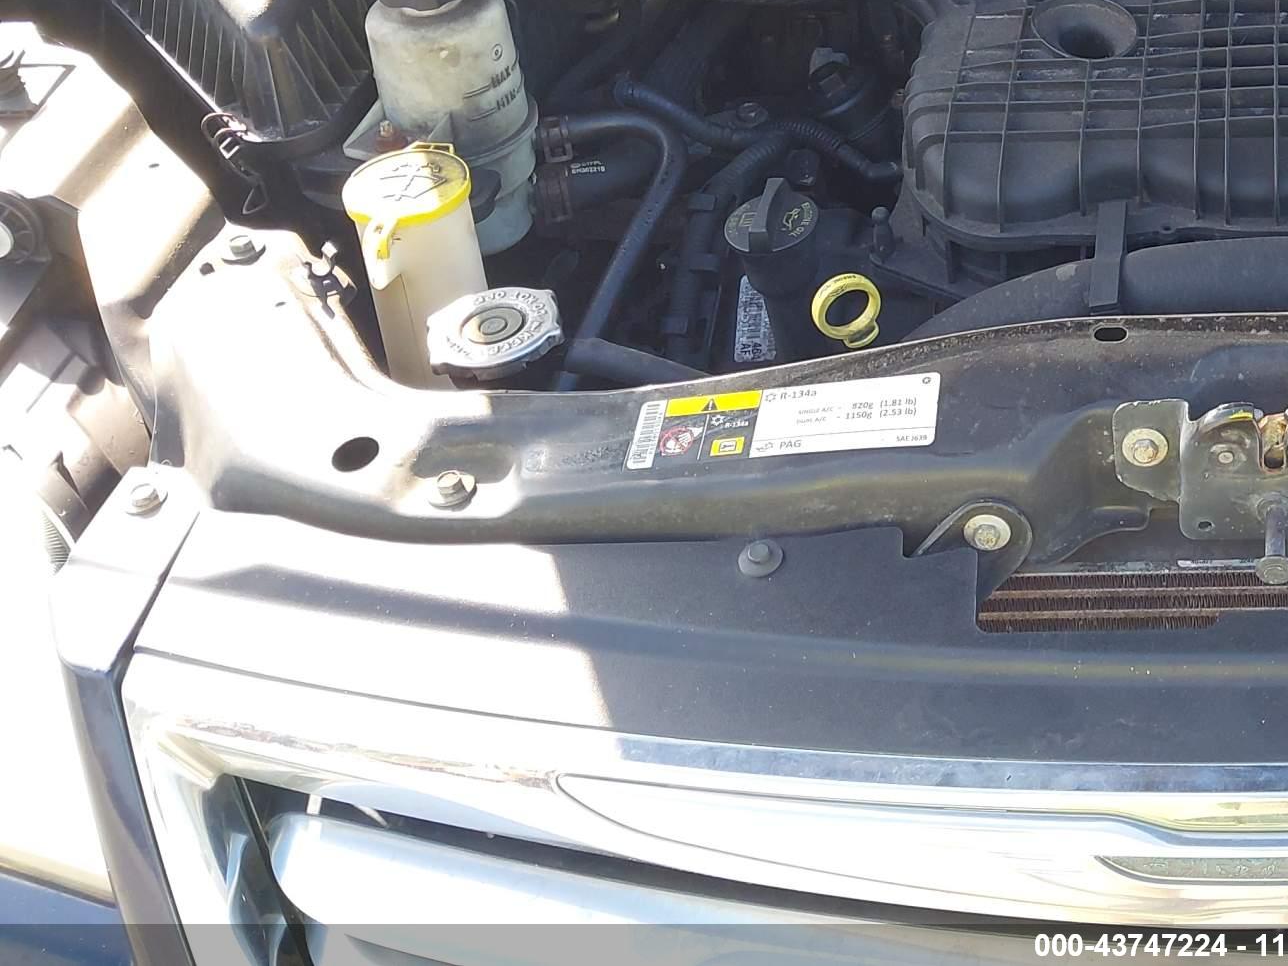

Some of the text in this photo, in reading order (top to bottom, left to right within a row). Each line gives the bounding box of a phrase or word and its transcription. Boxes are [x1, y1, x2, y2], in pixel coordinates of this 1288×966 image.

[780, 390, 817, 400] R-134a
[880, 399, 902, 408] (1.81
[904, 398, 917, 407] lb)
[845, 411, 872, 420] 1150g
[879, 409, 902, 418] (2.53
[904, 408, 917, 417] lb)
[779, 439, 802, 449] PAG
